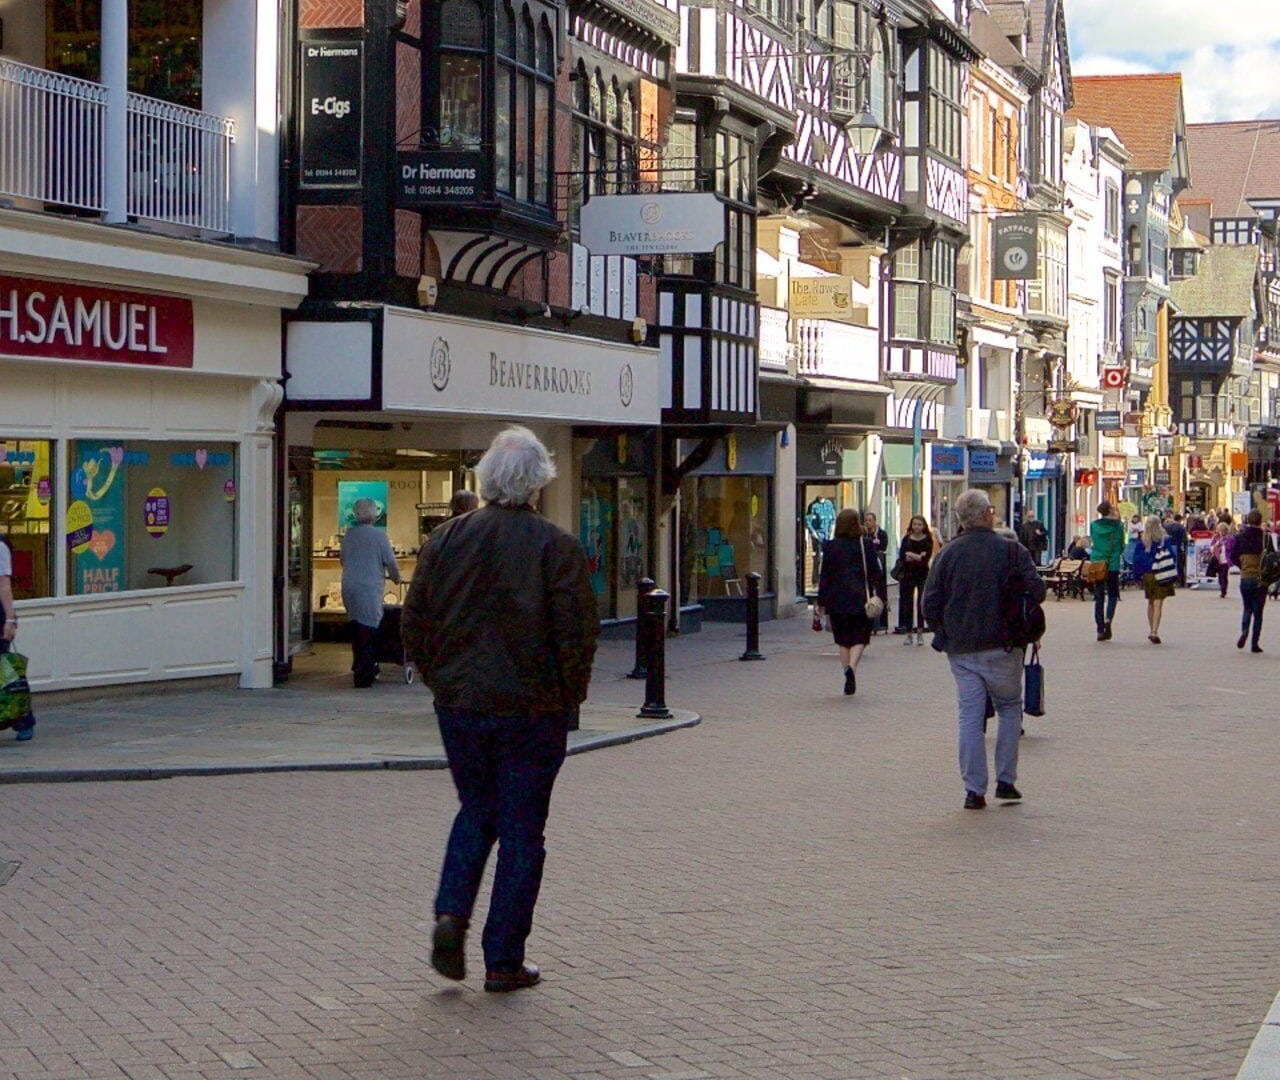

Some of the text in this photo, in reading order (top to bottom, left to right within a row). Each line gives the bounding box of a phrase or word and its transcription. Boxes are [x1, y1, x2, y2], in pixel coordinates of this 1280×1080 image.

[308, 48, 319, 57] Dr
[311, 96, 351, 118] E-Cigs
[402, 165, 418, 179] Dr
[792, 279, 840, 295] The Rows
[489, 351, 592, 396] BEAVERBROOKS
[82, 568, 120, 584] HALF
